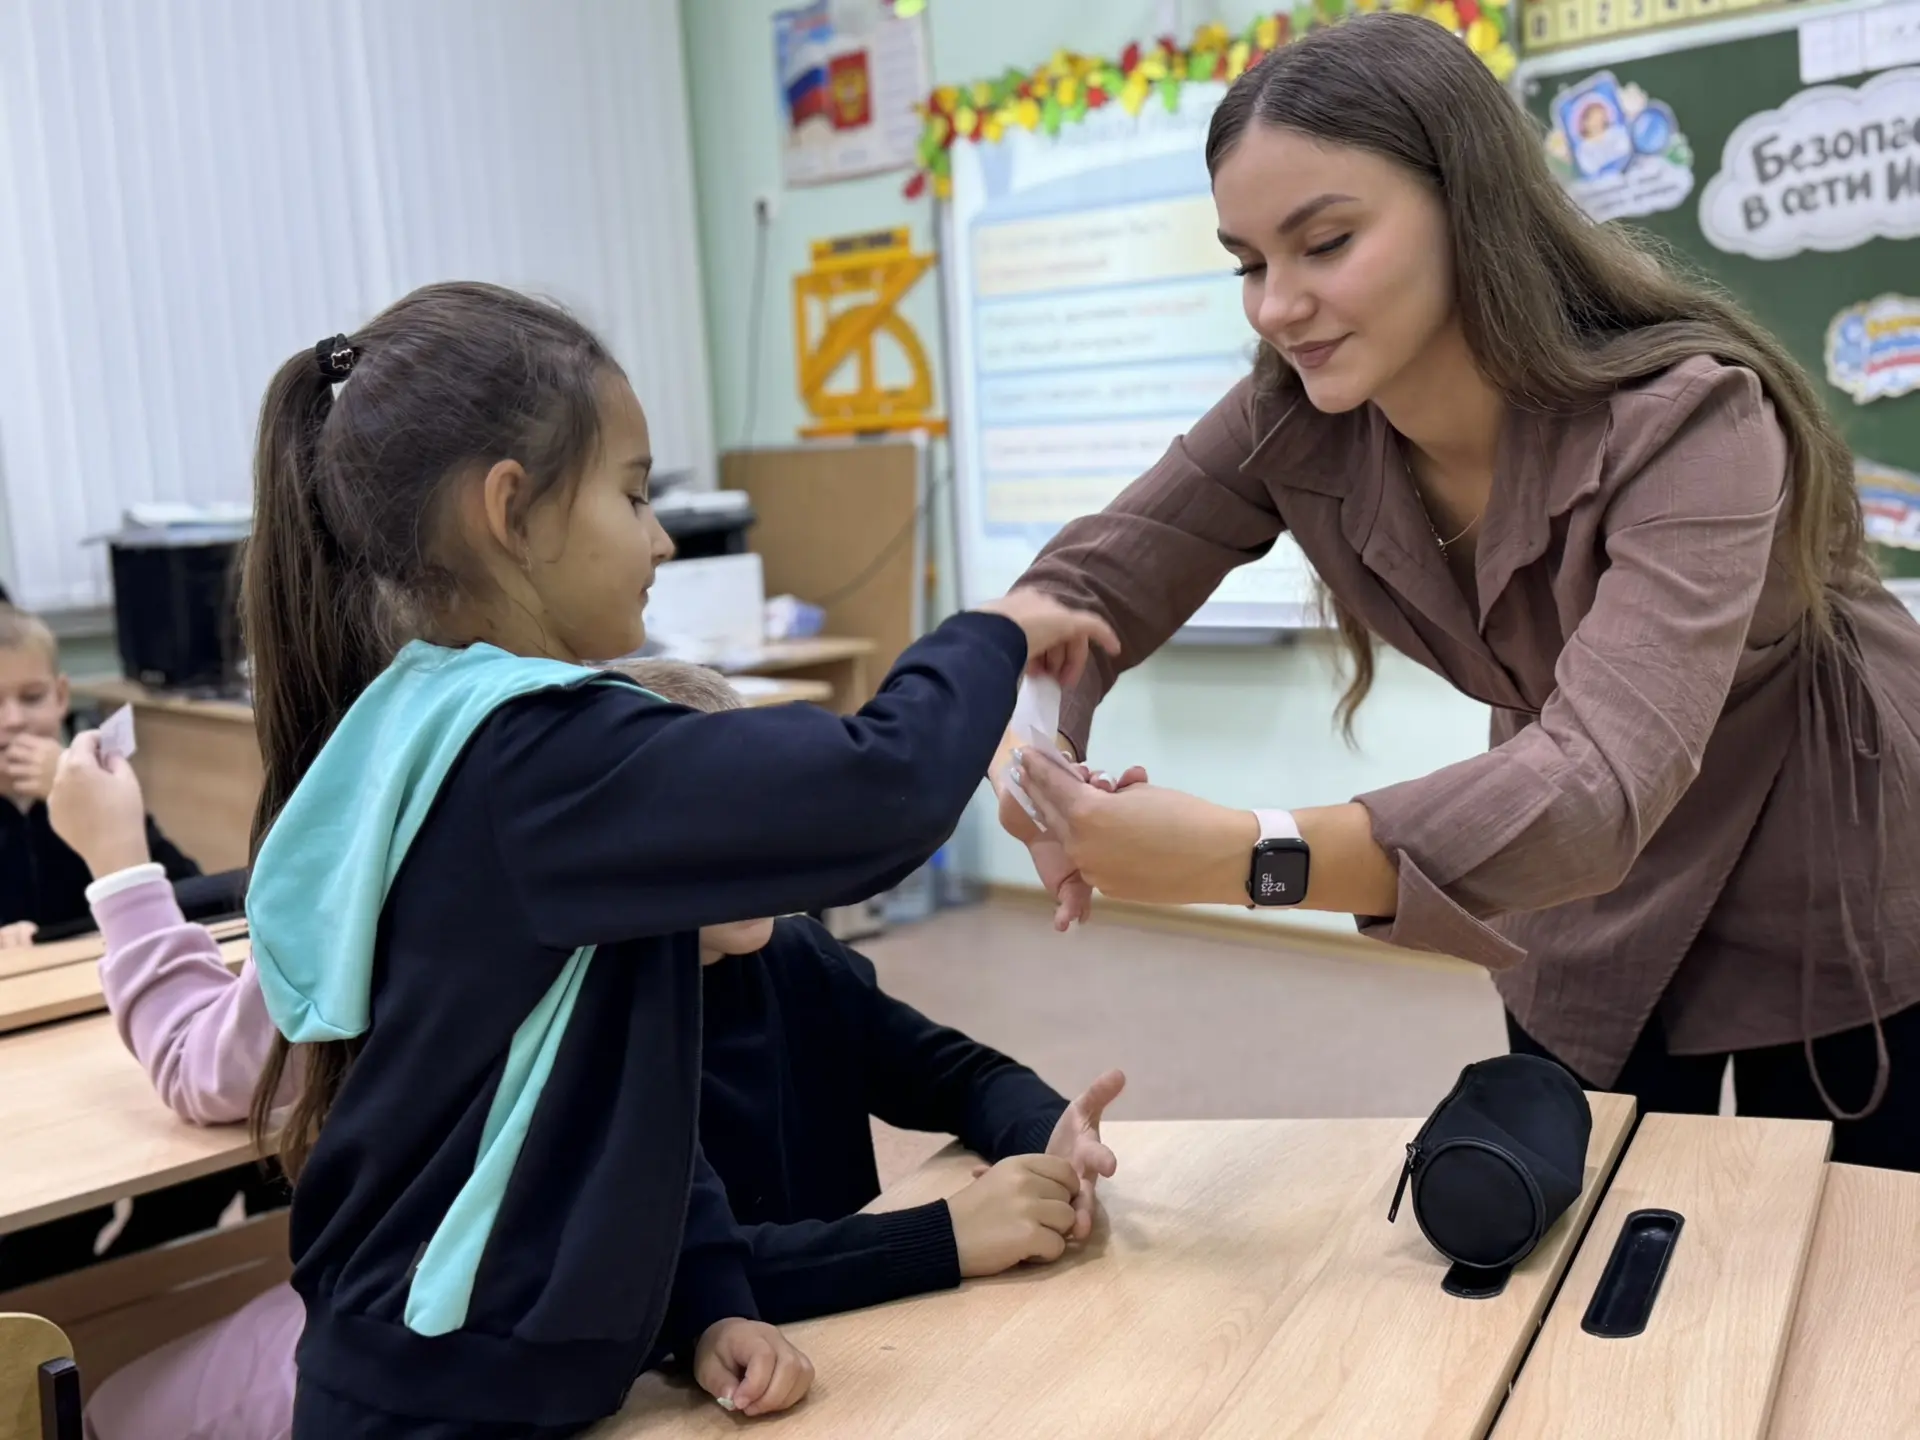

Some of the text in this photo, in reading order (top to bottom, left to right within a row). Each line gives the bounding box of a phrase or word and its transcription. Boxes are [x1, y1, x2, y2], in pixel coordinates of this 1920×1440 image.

[1781, 171, 1871, 215] сети
[1261, 873, 1273, 882] 15
[1261, 882, 1286, 892] 12:23
